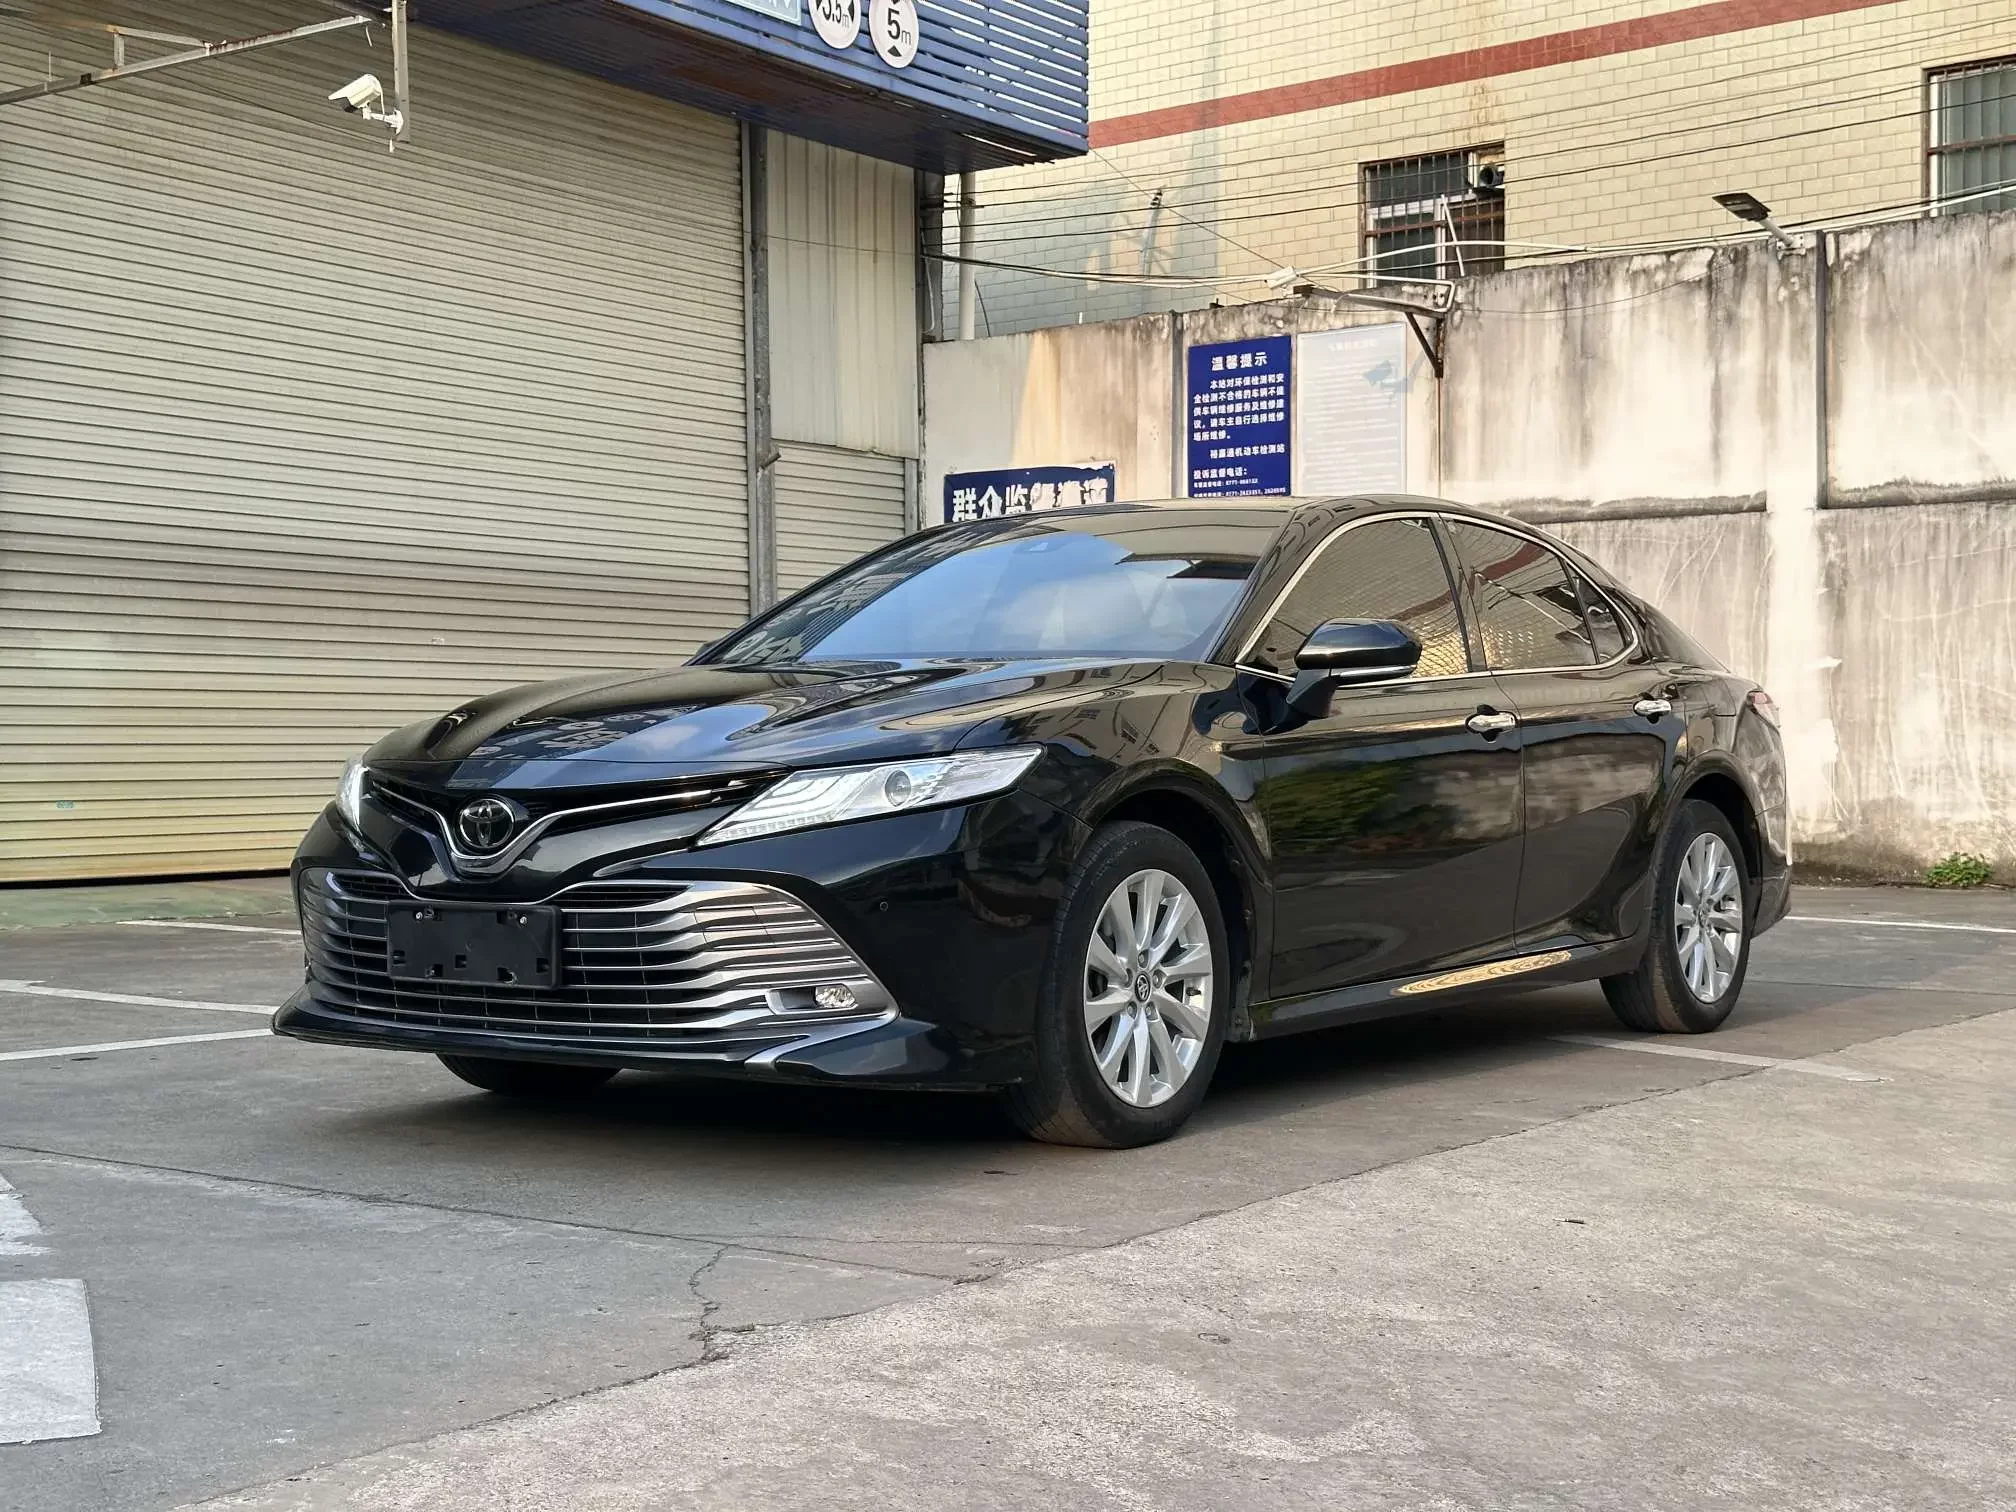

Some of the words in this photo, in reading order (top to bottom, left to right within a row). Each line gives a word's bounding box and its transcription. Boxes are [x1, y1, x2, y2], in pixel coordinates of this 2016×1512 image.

[887, 8, 911, 44] 5m
[1211, 352, 1268, 371] 温馨提示
